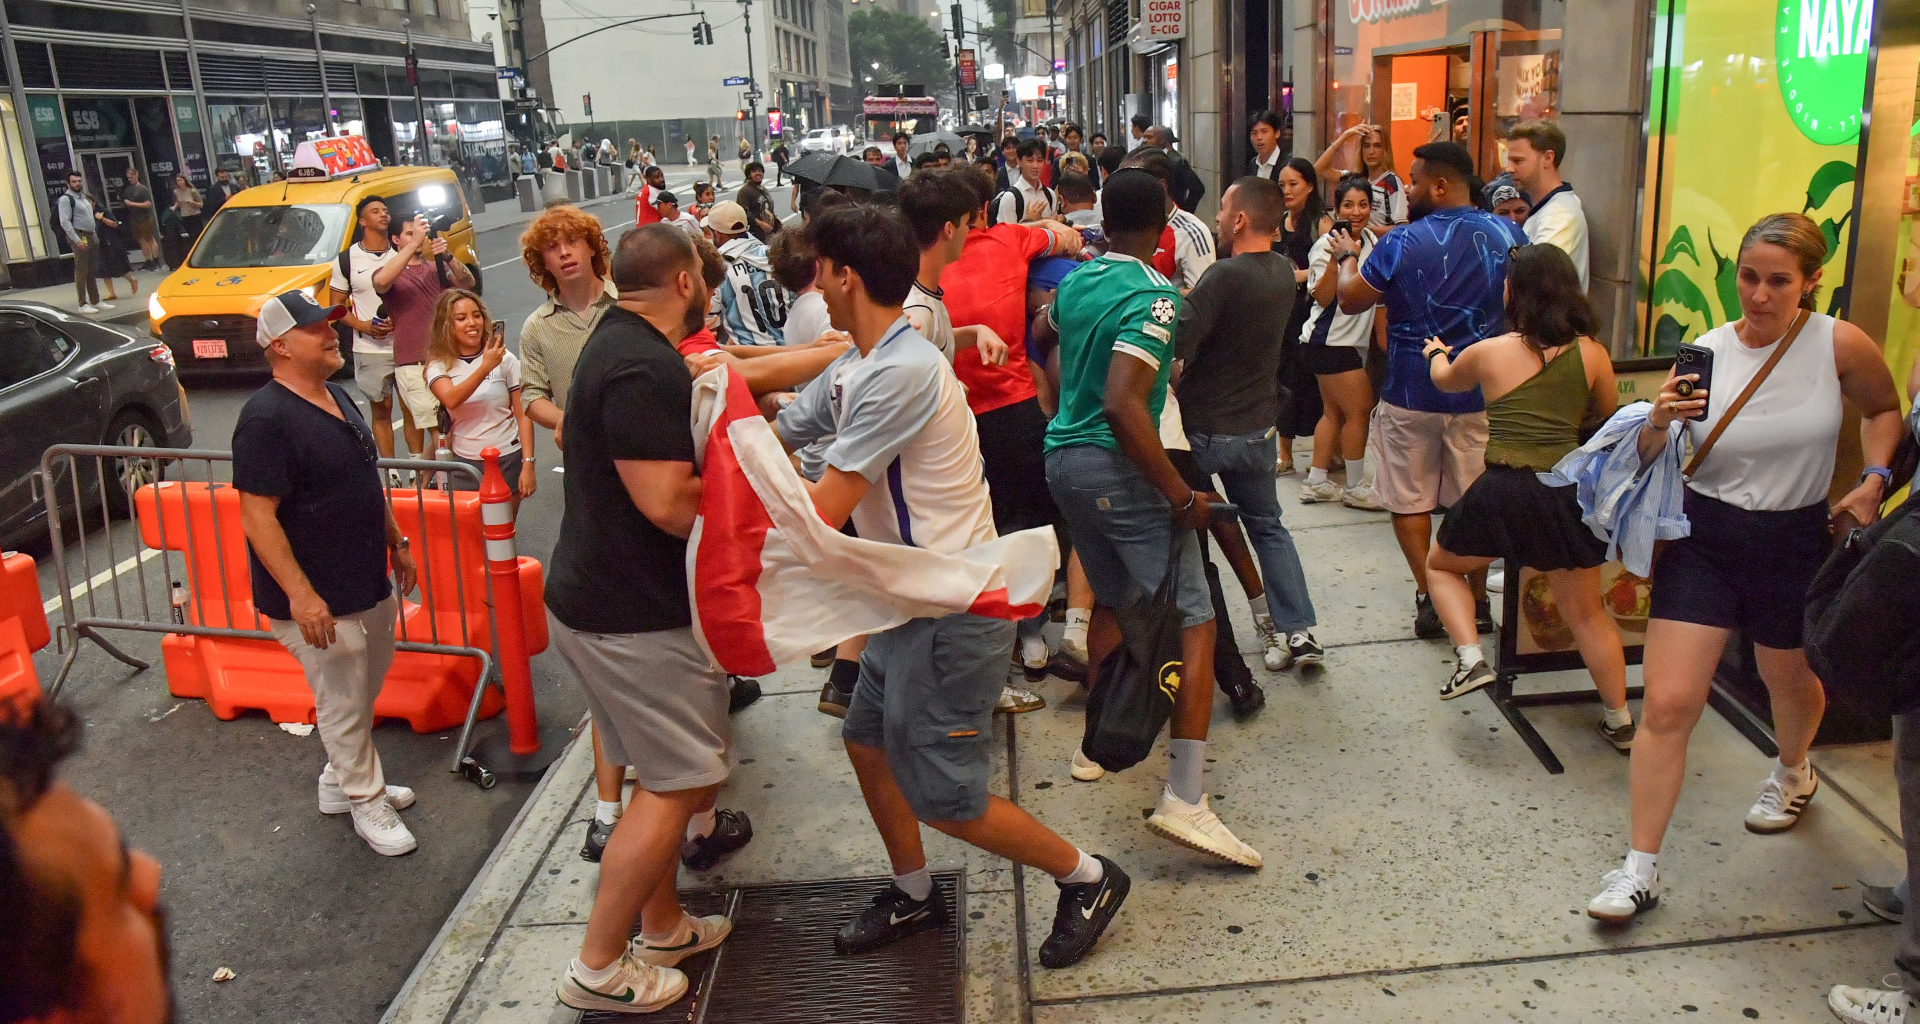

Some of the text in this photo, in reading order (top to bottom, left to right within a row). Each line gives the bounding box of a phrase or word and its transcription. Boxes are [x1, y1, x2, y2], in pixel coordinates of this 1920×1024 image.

[1149, 1, 1181, 11] CIGAR
[1149, 13, 1181, 23] LOTTO
[1151, 25, 1180, 34] E-CIG
[1797, 0, 1873, 58] NAYA
[1781, 57, 1818, 131] MIDDLE
[34, 107, 55, 121] ESB
[177, 106, 193, 119] ESB
[72, 110, 100, 130] ESB
[151, 161, 174, 172] ESB
[741, 280, 787, 333] 10
[1617, 380, 1636, 394] AYA
